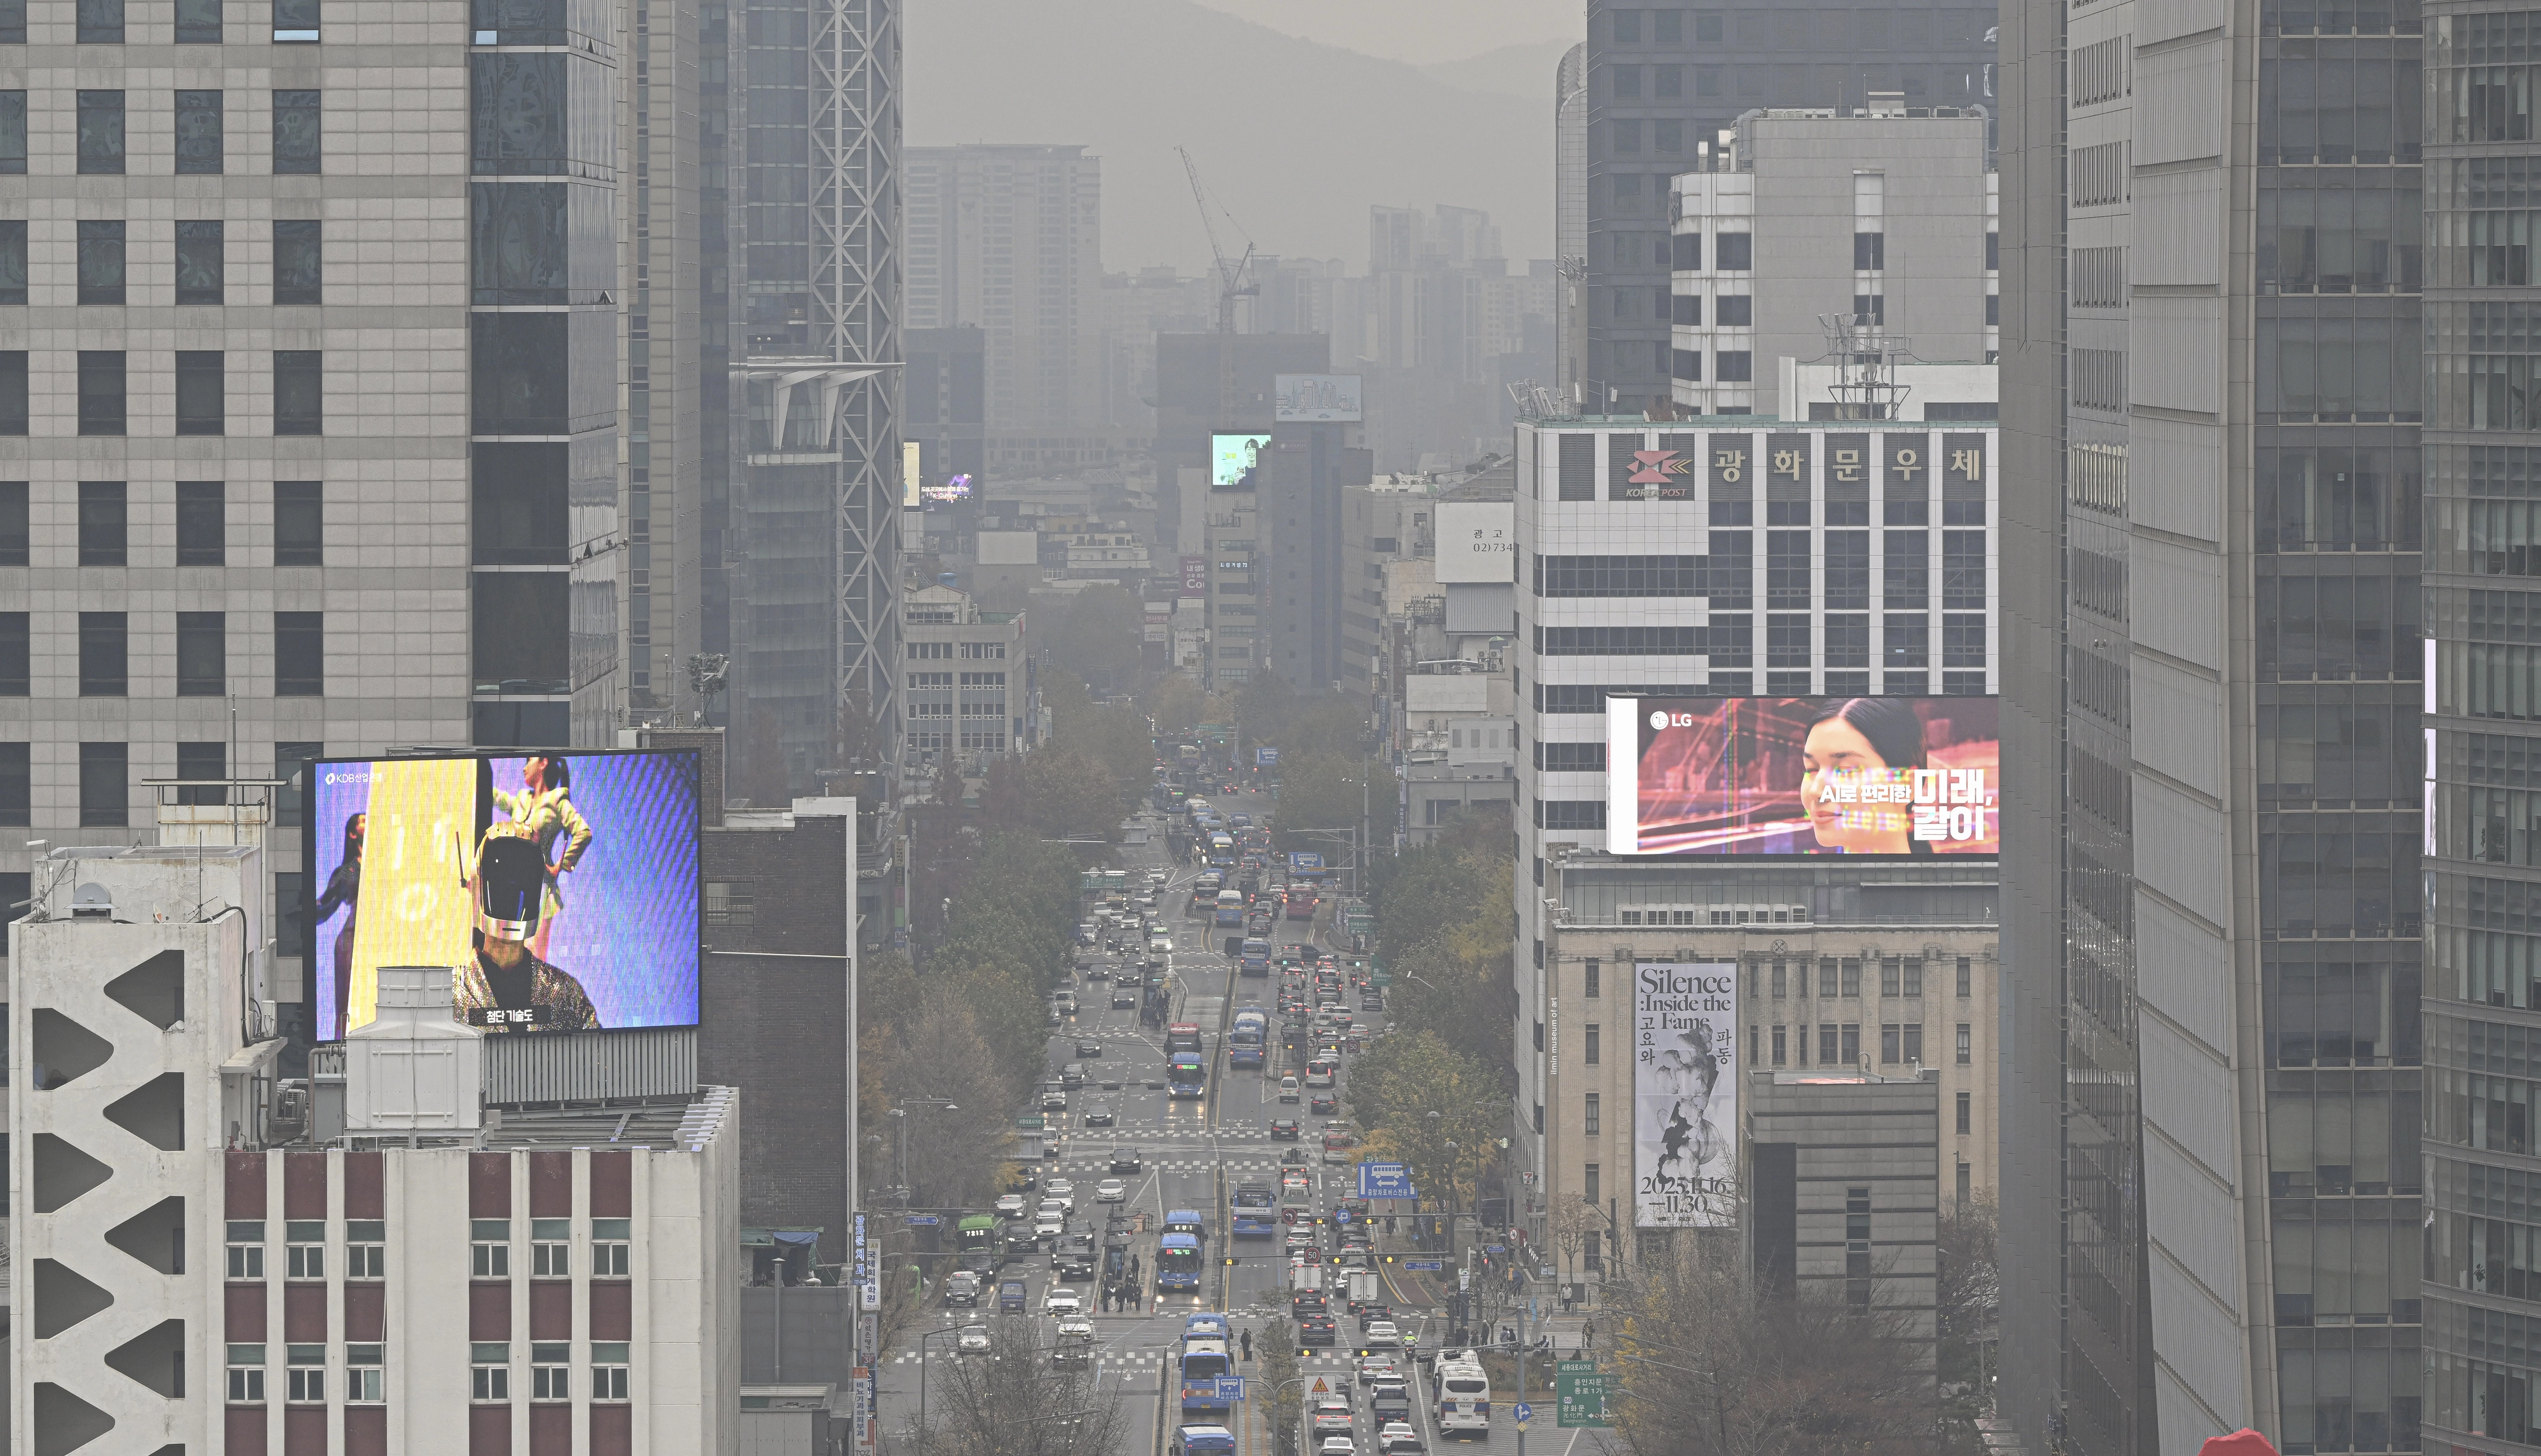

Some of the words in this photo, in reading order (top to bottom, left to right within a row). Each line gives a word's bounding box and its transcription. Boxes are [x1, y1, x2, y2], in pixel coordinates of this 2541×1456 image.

[1626, 489, 1659, 497] KOREA
[1661, 489, 1688, 497] POST
[1671, 713, 1692, 727] LG
[1819, 785, 1857, 803] AI로
[1860, 784, 1912, 804] 편리한
[1913, 806, 1985, 841] 같이
[1640, 968, 1732, 994] Silence
[1702, 994, 1732, 1011] the
[1550, 1009, 1557, 1018] of
[1661, 1012, 1710, 1030] Fame
[1716, 1028, 1732, 1065] 파동
[866, 1251, 876, 1302] 국제회계학원
[856, 1382, 865, 1410] 비뇨기과
[856, 1417, 865, 1437] 피부과
